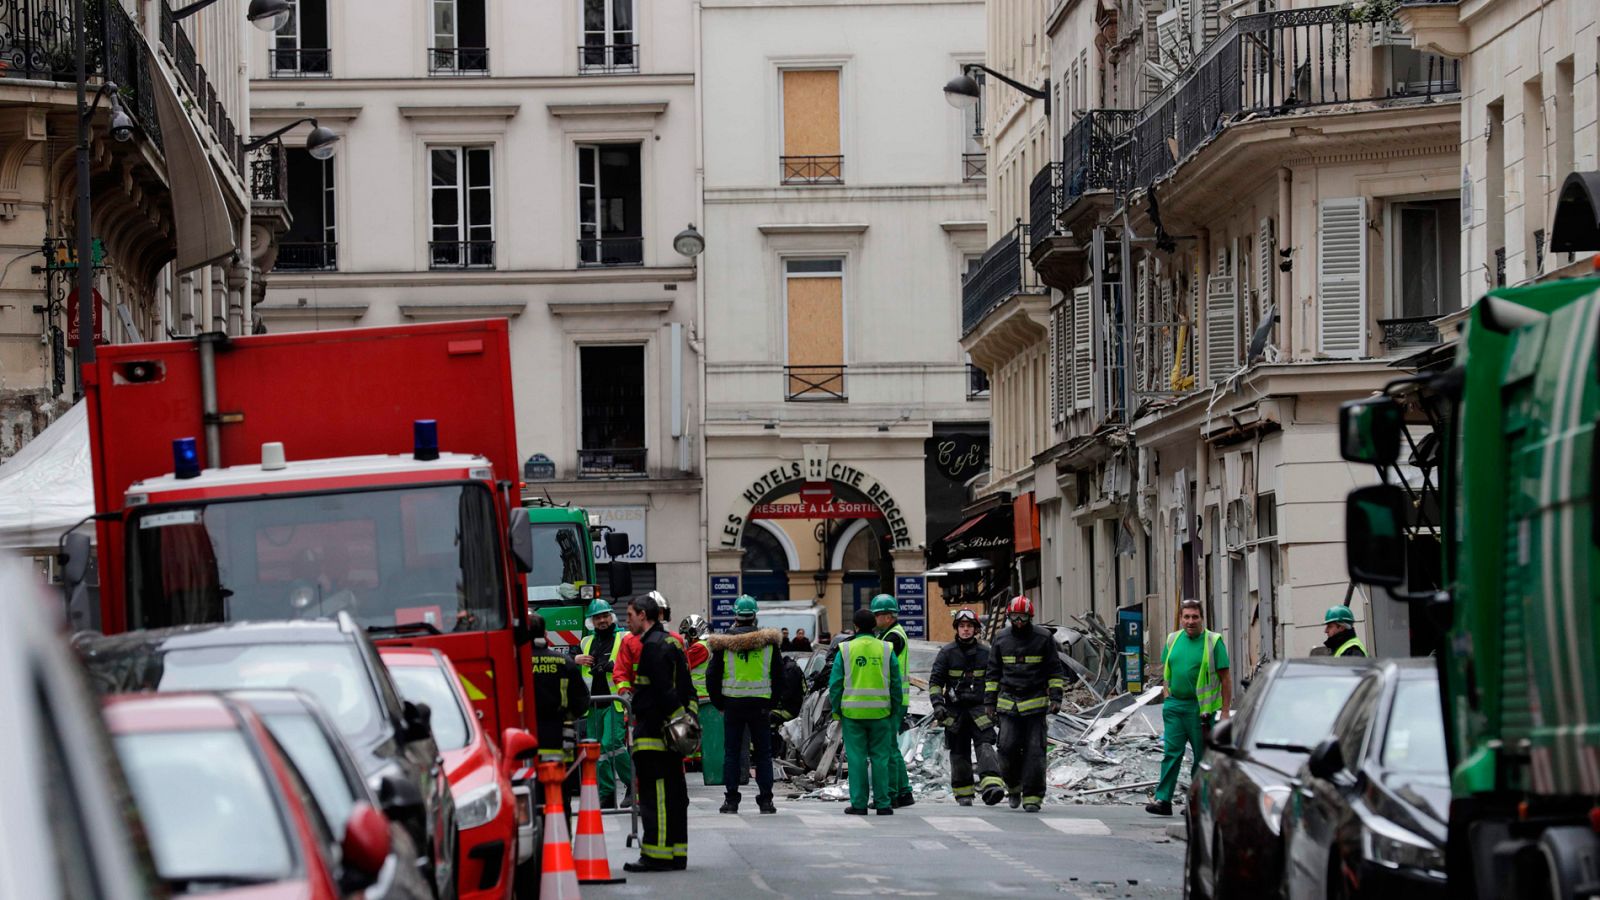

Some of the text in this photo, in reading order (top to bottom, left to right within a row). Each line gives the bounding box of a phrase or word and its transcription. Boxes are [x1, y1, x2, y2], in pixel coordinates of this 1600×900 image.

[810, 459, 822, 467] DE
[810, 468, 822, 477] LA
[721, 462, 911, 548] LES HOTELS CITE BERGERE
[754, 503, 879, 513] RESERVE A LA SORTIE
[968, 536, 1009, 547] Bistro
[1129, 622, 1137, 636] P
